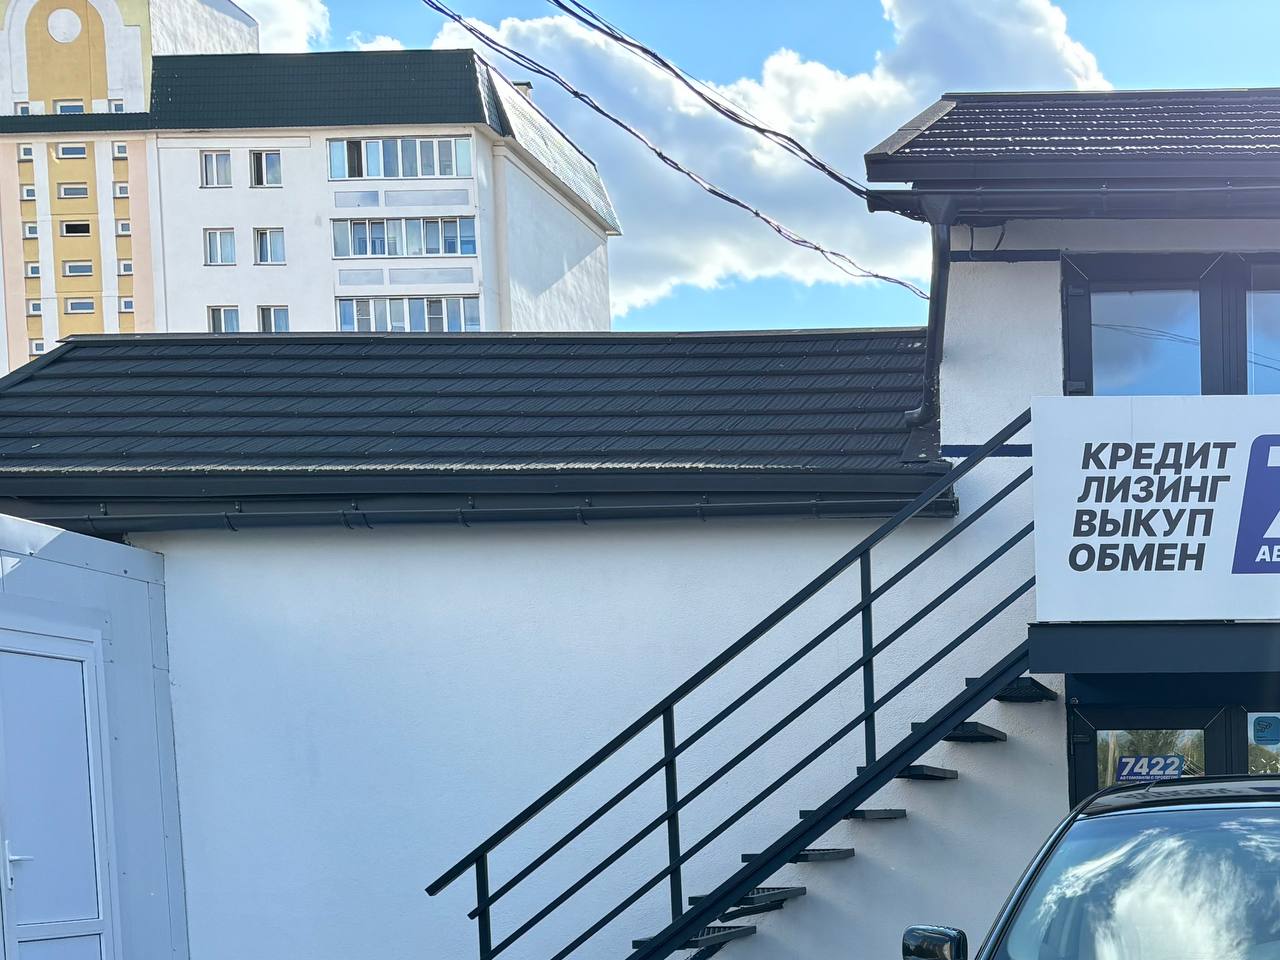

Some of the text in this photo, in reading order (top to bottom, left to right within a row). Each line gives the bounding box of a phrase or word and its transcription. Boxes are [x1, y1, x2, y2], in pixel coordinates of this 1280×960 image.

[1081, 442, 1236, 475] КРЕДИТ
[1077, 475, 1231, 503] ЛИЗИНГ
[1072, 508, 1214, 537] ВЫКУП
[1068, 542, 1206, 572] ОБМЕН
[1121, 756, 1180, 776] 7422
